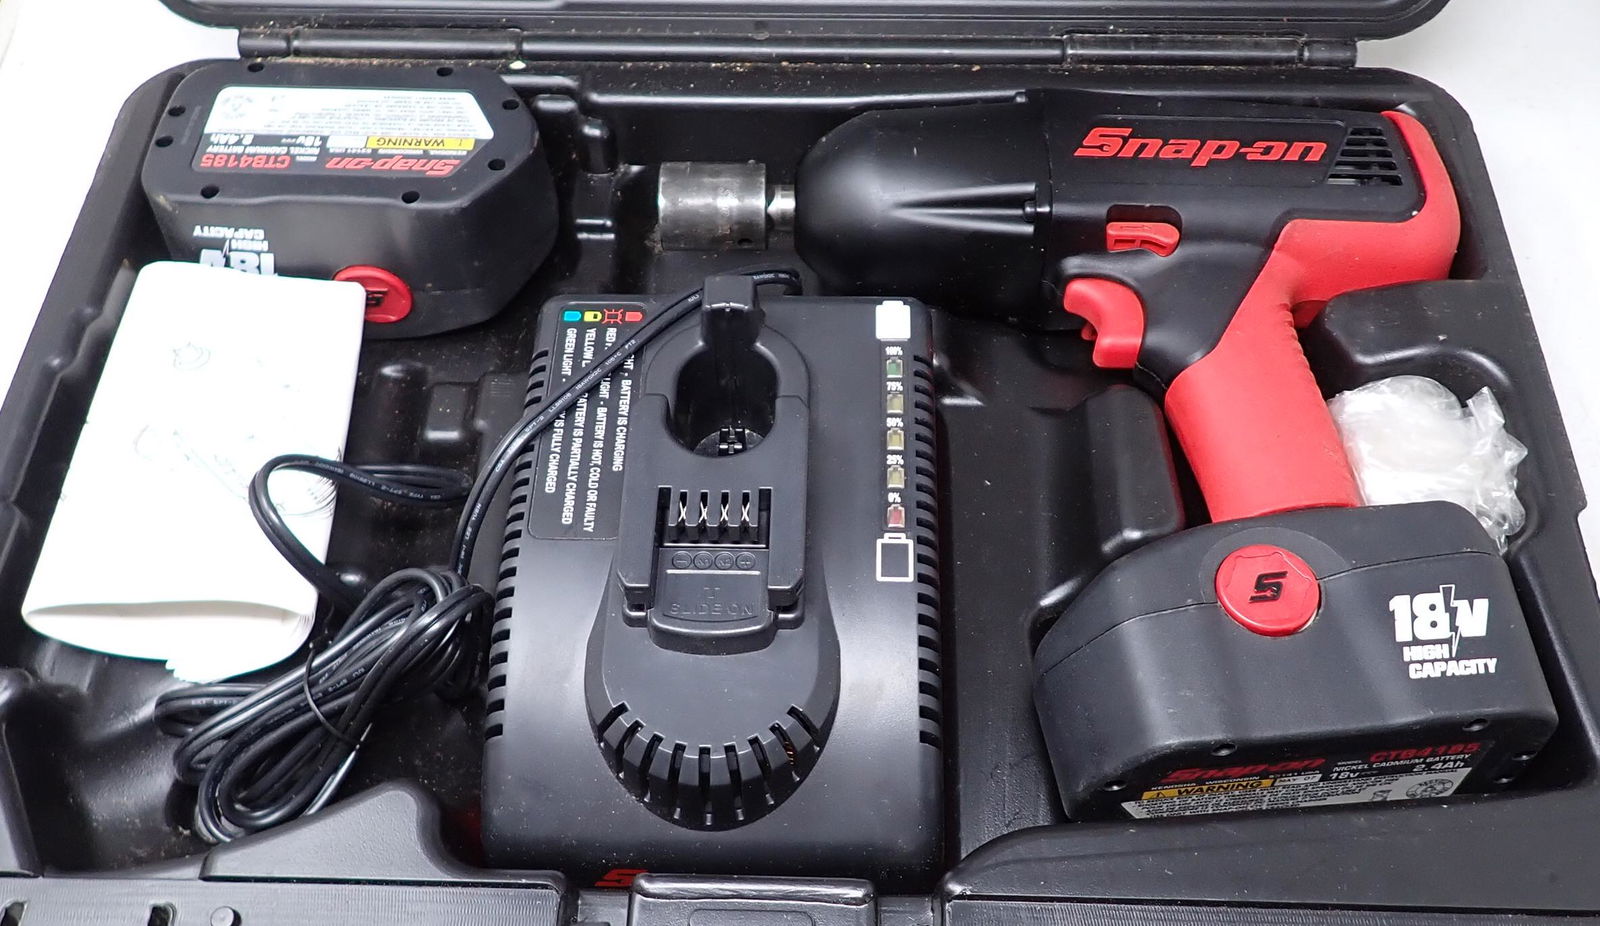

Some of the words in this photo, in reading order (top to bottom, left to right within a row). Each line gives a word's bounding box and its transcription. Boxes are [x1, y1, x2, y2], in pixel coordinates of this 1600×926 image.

[376, 137, 446, 147] WARNING
[1074, 127, 1327, 167] Snap-on
[200, 154, 292, 169] CTB4185
[326, 156, 460, 176] Snap-on
[193, 225, 265, 240] CAPACITY
[231, 239, 269, 252] HIGH
[564, 328, 577, 354] GREEN
[606, 328, 617, 342] RED
[582, 328, 597, 360] YELLOW
[885, 346, 903, 356] 100%
[561, 354, 574, 376] LIGHT
[886, 381, 903, 391] 75%
[618, 380, 632, 416] BATTERY
[554, 419, 564, 428] IS
[594, 407, 608, 440] BATTERY
[618, 417, 628, 426] IS
[886, 417, 904, 428] 50%
[550, 428, 564, 453] FULLY
[573, 428, 584, 437] IS
[593, 440, 604, 448] IS
[612, 426, 627, 472] CHARGING
[568, 438, 582, 482] PARTIALLY
[590, 449, 602, 466] HOT,
[886, 454, 904, 465] 25%
[545, 454, 560, 493] CHARGED
[588, 467, 600, 488] COLD
[562, 482, 576, 524] CHARGED
[587, 490, 598, 502] OR
[888, 492, 902, 502] 0%
[583, 502, 597, 532] FAULTY
[671, 603, 722, 616] SLIDE
[728, 602, 752, 615] ON
[1402, 643, 1450, 662] HIGH
[1408, 658, 1498, 679] CAPACITY
[1370, 742, 1482, 763] CTB4185
[1332, 762, 1370, 772] NICKEL
[1372, 757, 1424, 768] CADMIUM
[1426, 753, 1472, 763] BATTERY
[1412, 761, 1464, 772] 2.4Ah
[1176, 781, 1263, 796] WARNING
